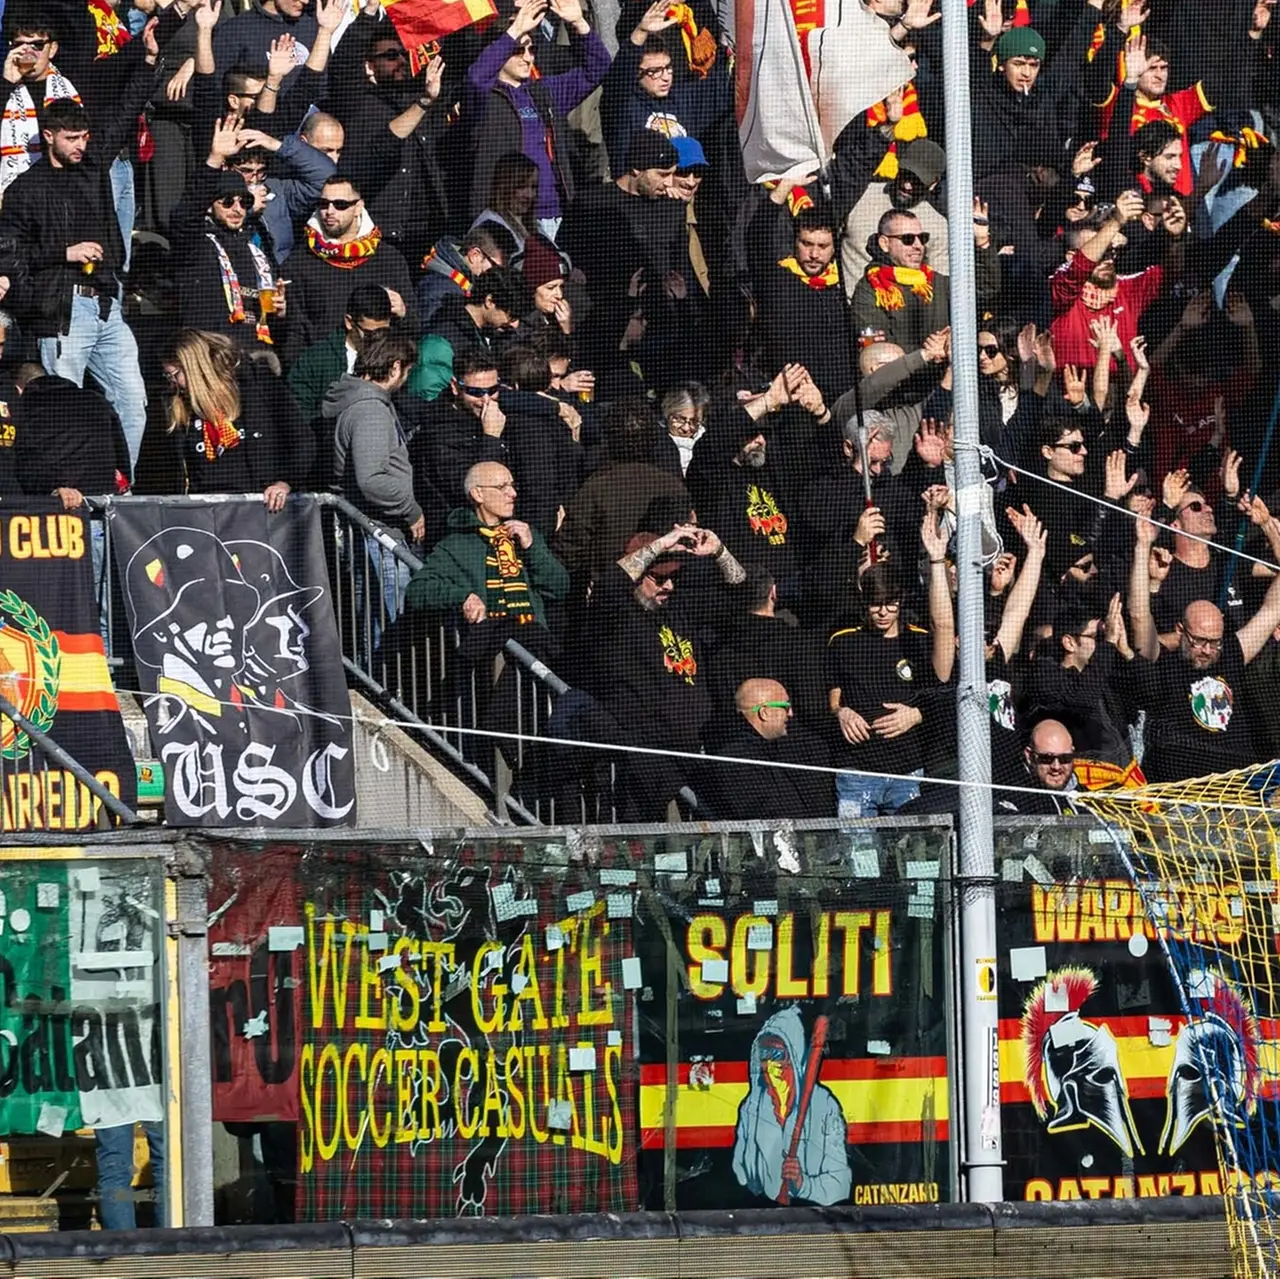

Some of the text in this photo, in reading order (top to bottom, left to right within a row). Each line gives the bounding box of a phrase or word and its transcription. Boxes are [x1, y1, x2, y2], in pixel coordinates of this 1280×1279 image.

[9, 514, 86, 560] CLUB
[163, 741, 356, 821] USC
[303, 898, 615, 1033] WEST GATE
[687, 910, 894, 1000] SOLITI
[300, 1042, 441, 1174] SOCCER
